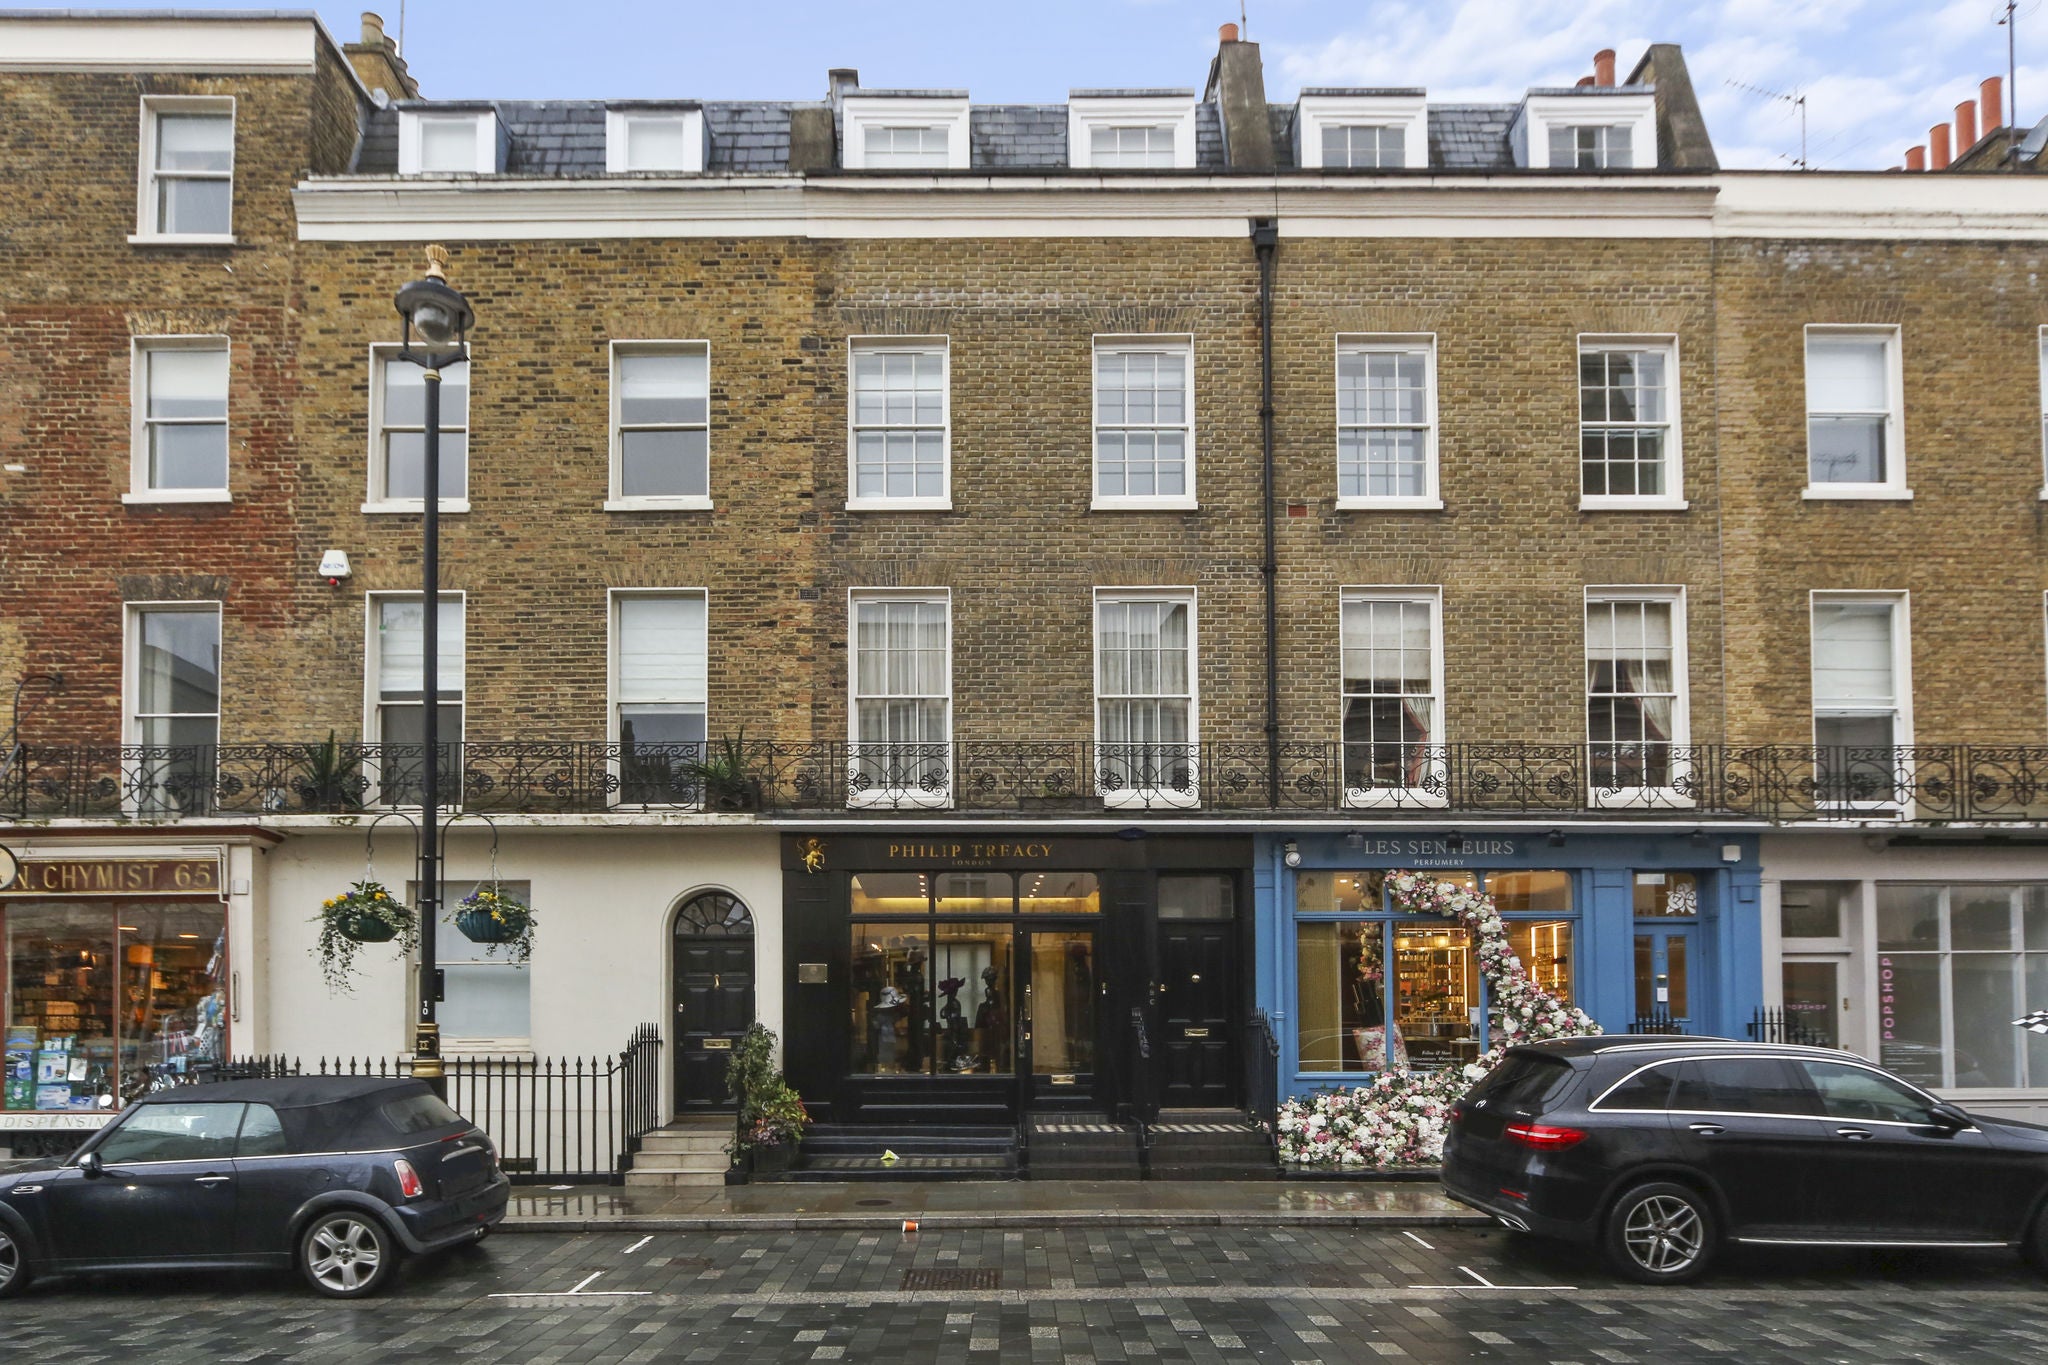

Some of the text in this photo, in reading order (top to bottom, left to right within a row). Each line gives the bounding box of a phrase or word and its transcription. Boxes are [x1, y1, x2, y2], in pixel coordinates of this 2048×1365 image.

[888, 844, 1054, 858] PHILIP TREACY
[1364, 840, 1401, 855] LES
[951, 859, 993, 867] LONDON
[1414, 858, 1465, 867] PERFUMERY
[43, 864, 159, 889] CHYMIST
[174, 863, 212, 888] 65
[1881, 957, 1896, 1040] POPSHOP
[4, 1116, 106, 1129] DISPENSIN
